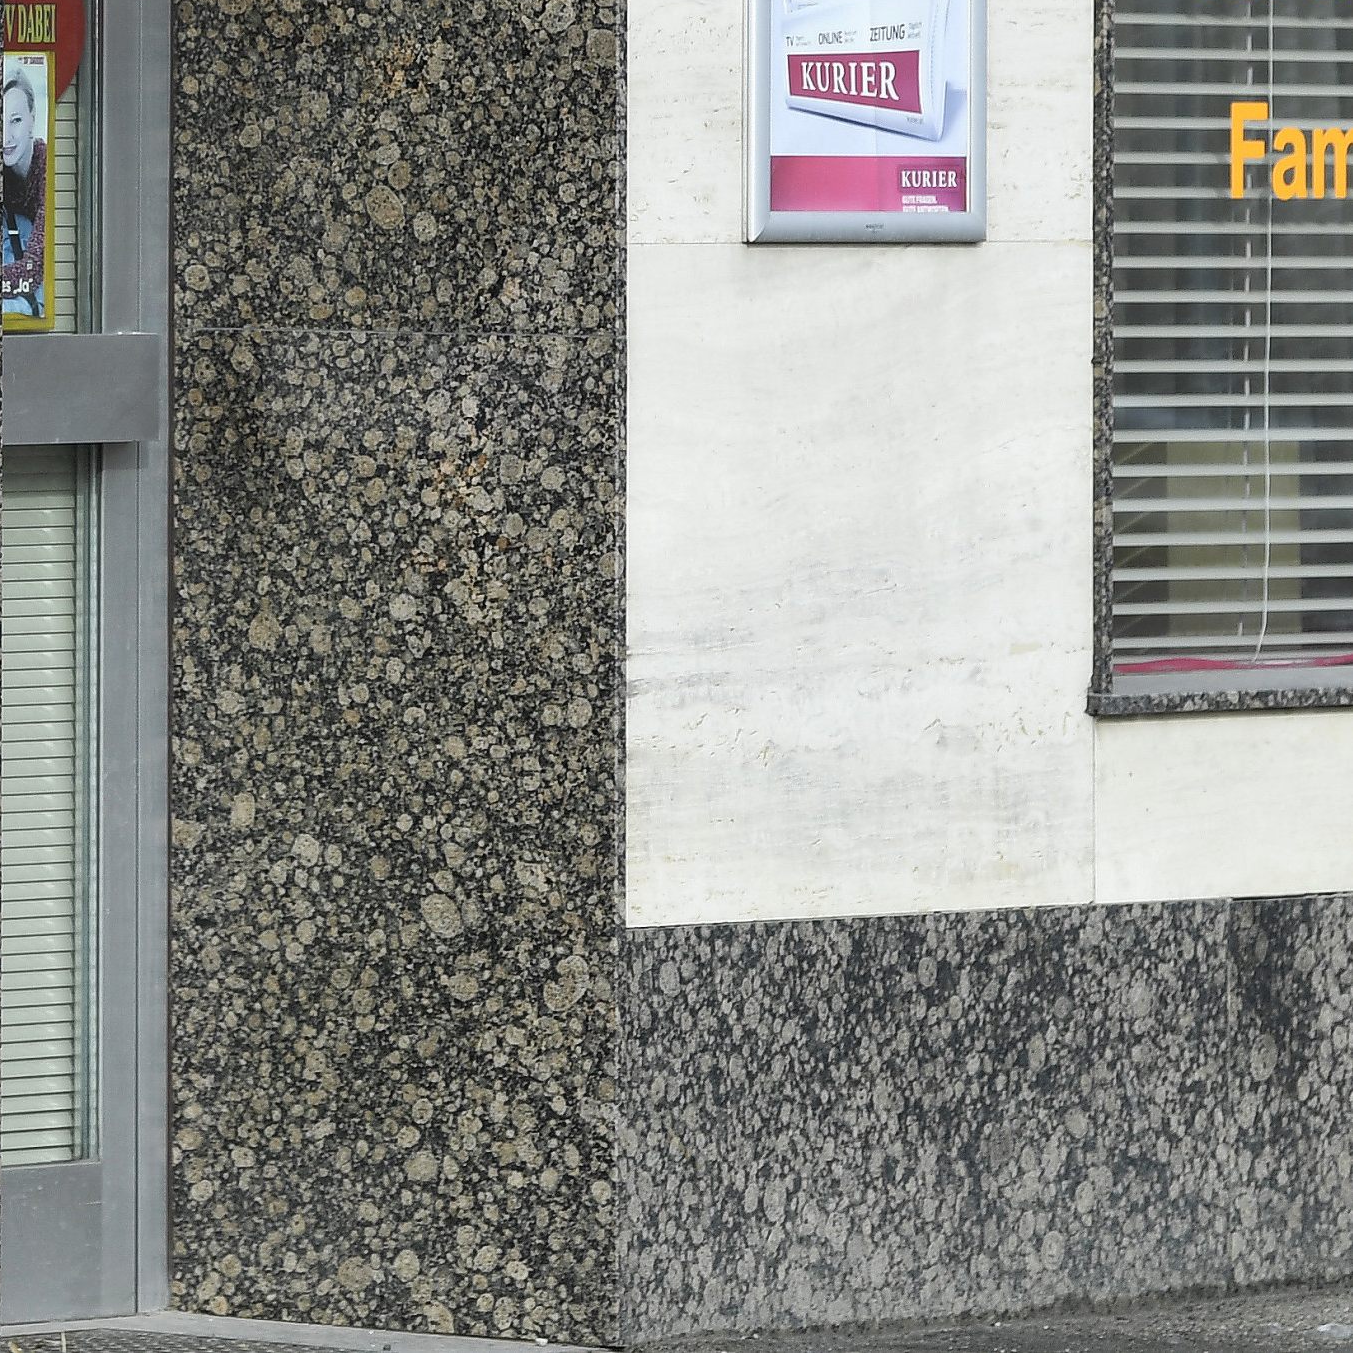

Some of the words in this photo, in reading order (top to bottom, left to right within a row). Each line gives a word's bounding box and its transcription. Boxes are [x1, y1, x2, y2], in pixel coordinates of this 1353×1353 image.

[17, 3, 56, 43] DABEI
[869, 24, 905, 42] ZEITUNG
[818, 31, 843, 45] ONLINE
[801, 61, 899, 100] KURIER
[1231, 101, 1353, 202] Fam
[901, 170, 958, 188] KURIER
